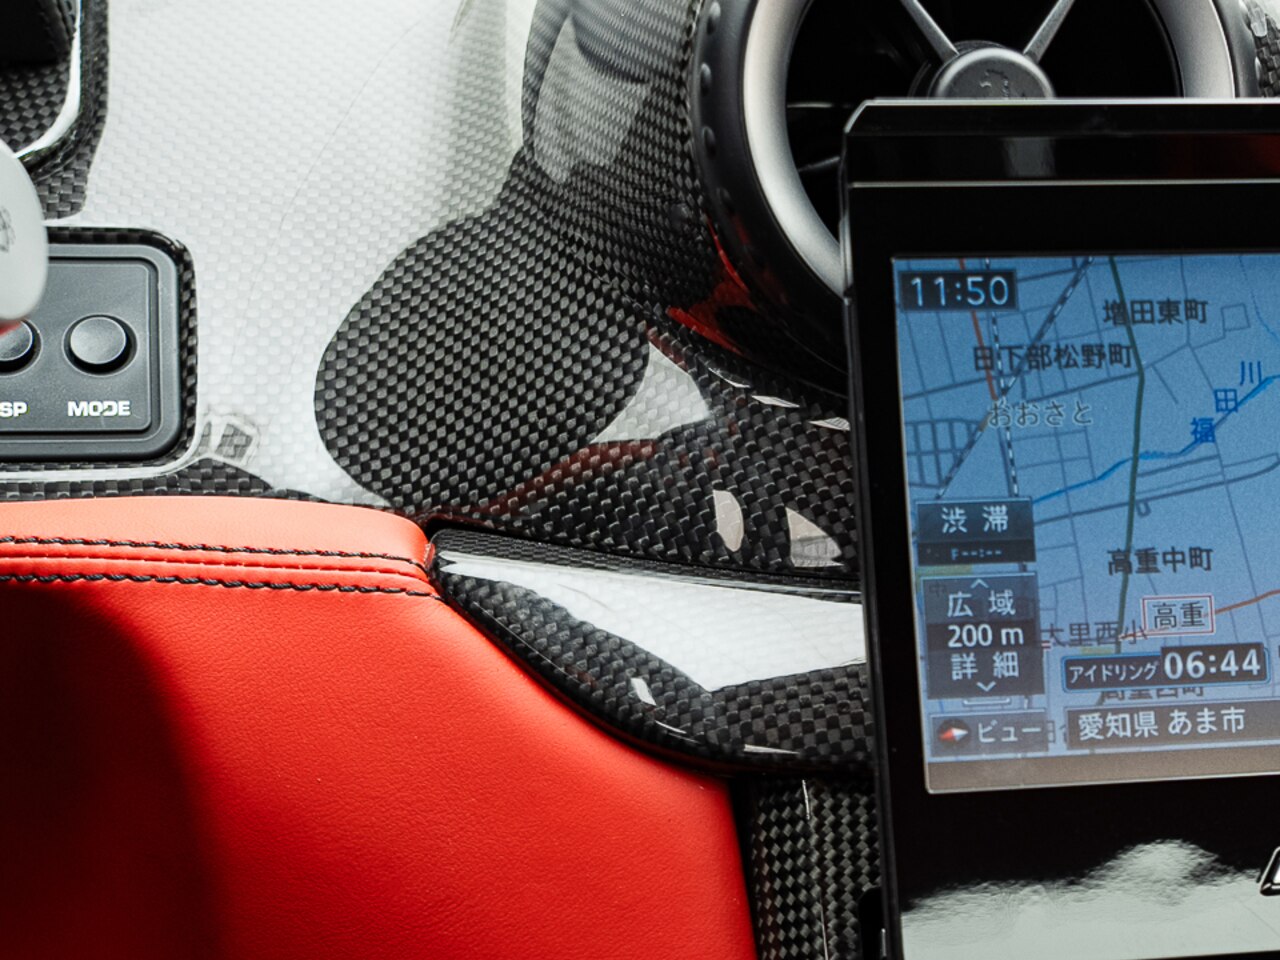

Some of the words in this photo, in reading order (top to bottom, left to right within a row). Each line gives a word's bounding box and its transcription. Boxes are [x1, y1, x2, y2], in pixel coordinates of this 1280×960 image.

[910, 275, 1009, 308] 11:50
[1102, 298, 1209, 326] 増田東町
[974, 343, 1134, 372] 日下部松野町
[67, 401, 131, 417] MODE
[987, 400, 1094, 428] おおさと
[1107, 546, 1214, 575] 高重中町
[1152, 600, 1206, 630] 高重
[947, 624, 993, 648] 200
[1001, 626, 1025, 646] m
[1068, 661, 1160, 684] アイドリング
[1163, 649, 1262, 680] 06:44
[977, 721, 1042, 745] ビュー
[1078, 710, 1160, 742] 愛知県
[1167, 707, 1247, 736] あま市
